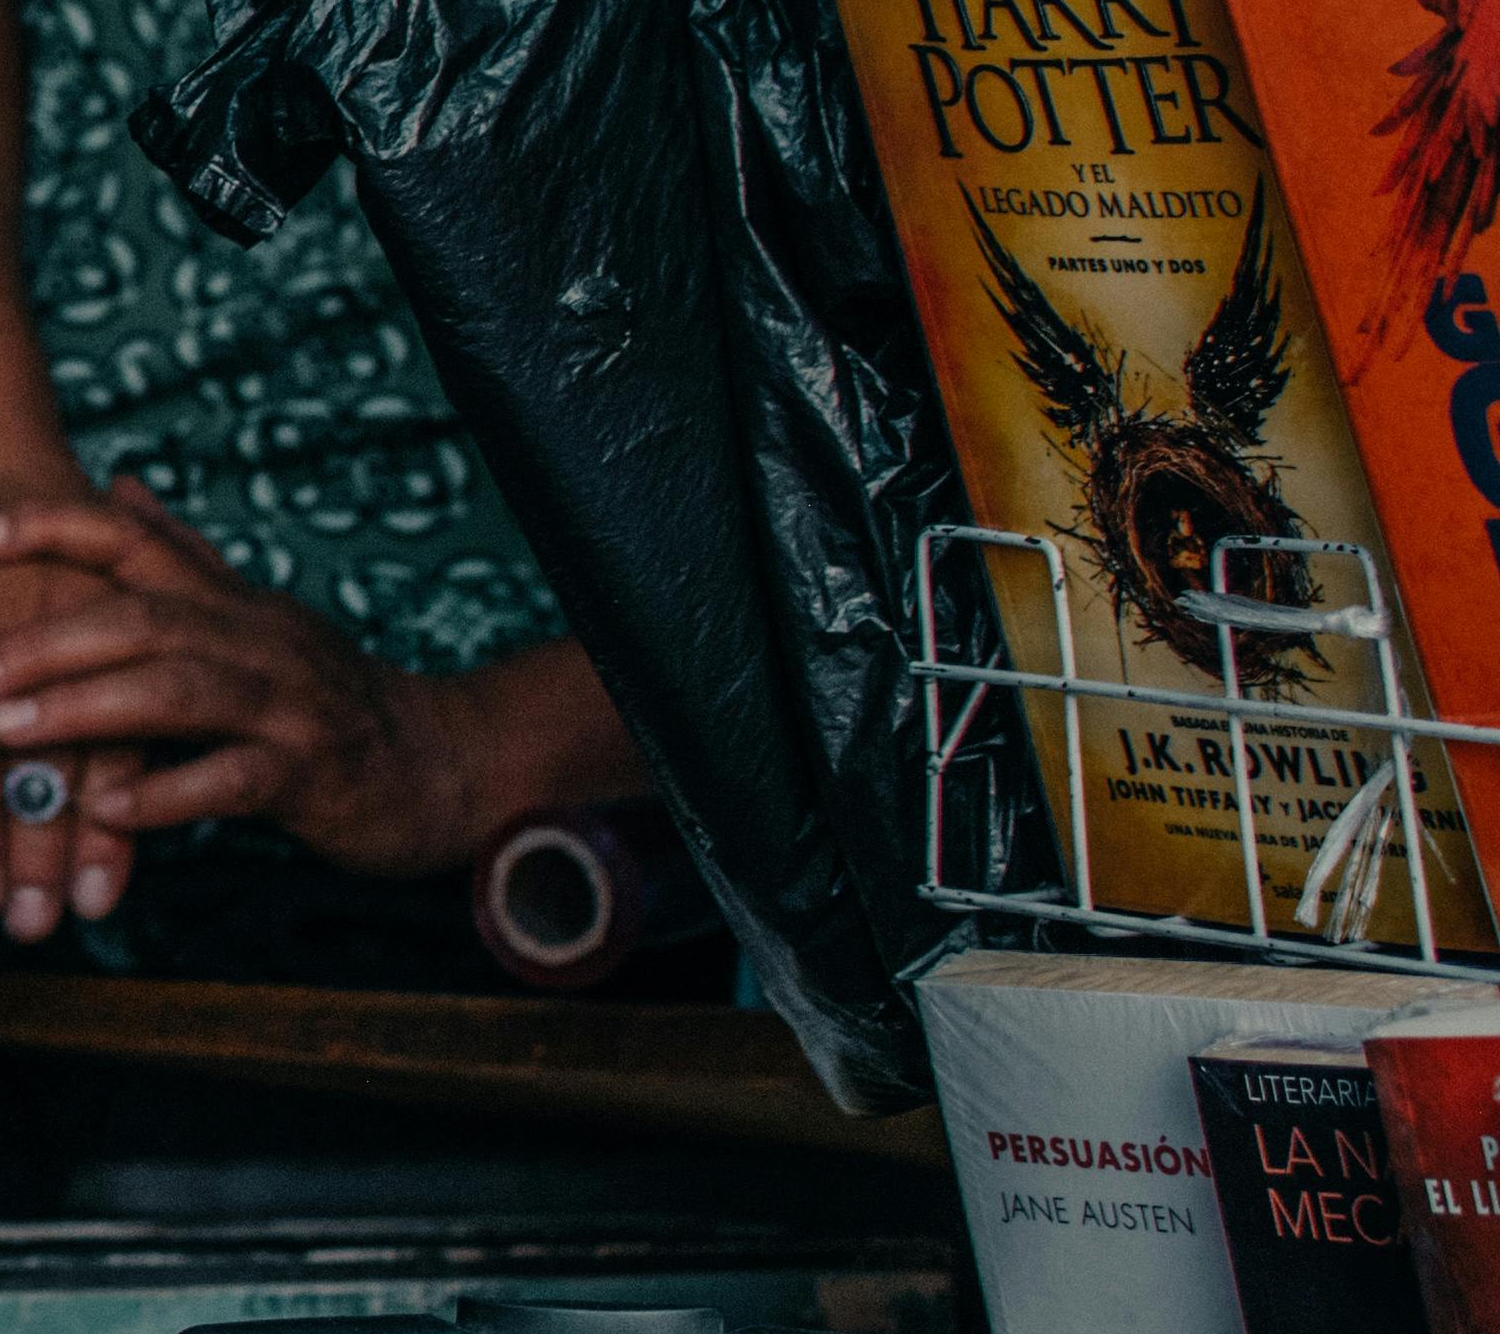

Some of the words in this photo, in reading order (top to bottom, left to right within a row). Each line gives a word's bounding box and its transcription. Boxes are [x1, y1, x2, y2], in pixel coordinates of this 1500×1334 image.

[909, 43, 1265, 160] POTTER
[1070, 163, 1086, 184] Y
[1091, 163, 1116, 184] EL
[979, 185, 1091, 220] LEGADO
[1098, 188, 1244, 220] MALDITO
[1048, 257, 1107, 274] PARTES
[1110, 258, 1149, 274] UNO
[1152, 260, 1164, 274] Y
[1168, 259, 1207, 274] DOS
[1170, 715, 1220, 731] BASADA
[1270, 724, 1328, 743] HISTORIA
[1329, 728, 1349, 743] DE
[1118, 727, 1195, 776] J.K.
[1107, 778, 1168, 805] JOHN
[987, 1130, 1212, 1180] PERSUASIÓN
[1252, 1123, 1323, 1177] LA
[1000, 1192, 1068, 1225] JANE
[1082, 1200, 1195, 1235] AUSTEN
[1424, 1178, 1462, 1215] EL
[1268, 1188, 1392, 1246] MEC
